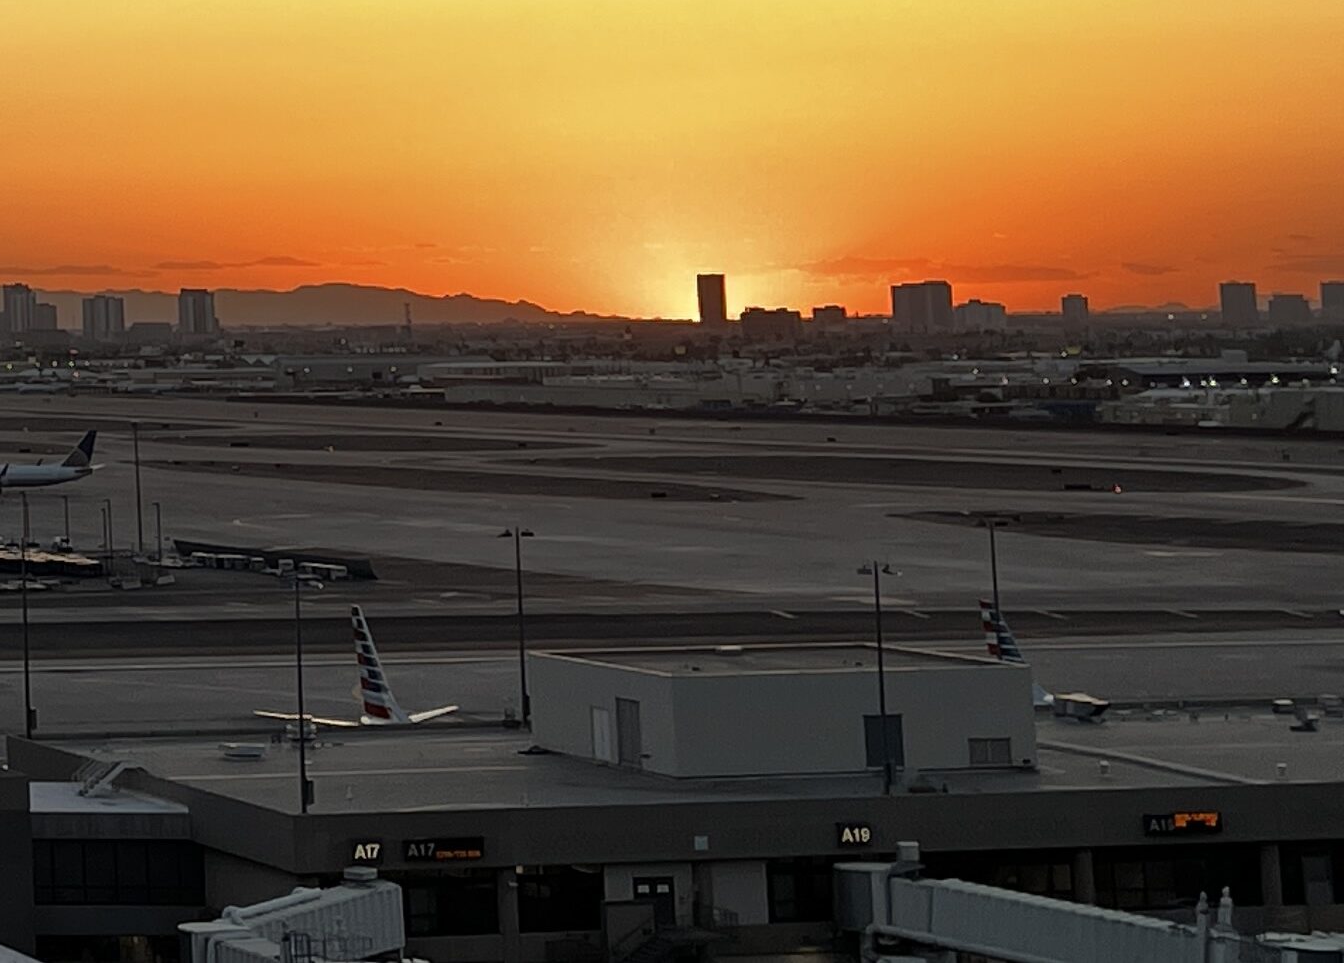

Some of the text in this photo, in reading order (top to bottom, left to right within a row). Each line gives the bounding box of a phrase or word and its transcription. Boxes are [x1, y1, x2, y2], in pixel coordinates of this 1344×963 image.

[841, 827, 871, 843] A19
[354, 843, 381, 859] A17
[408, 843, 436, 858] A17
